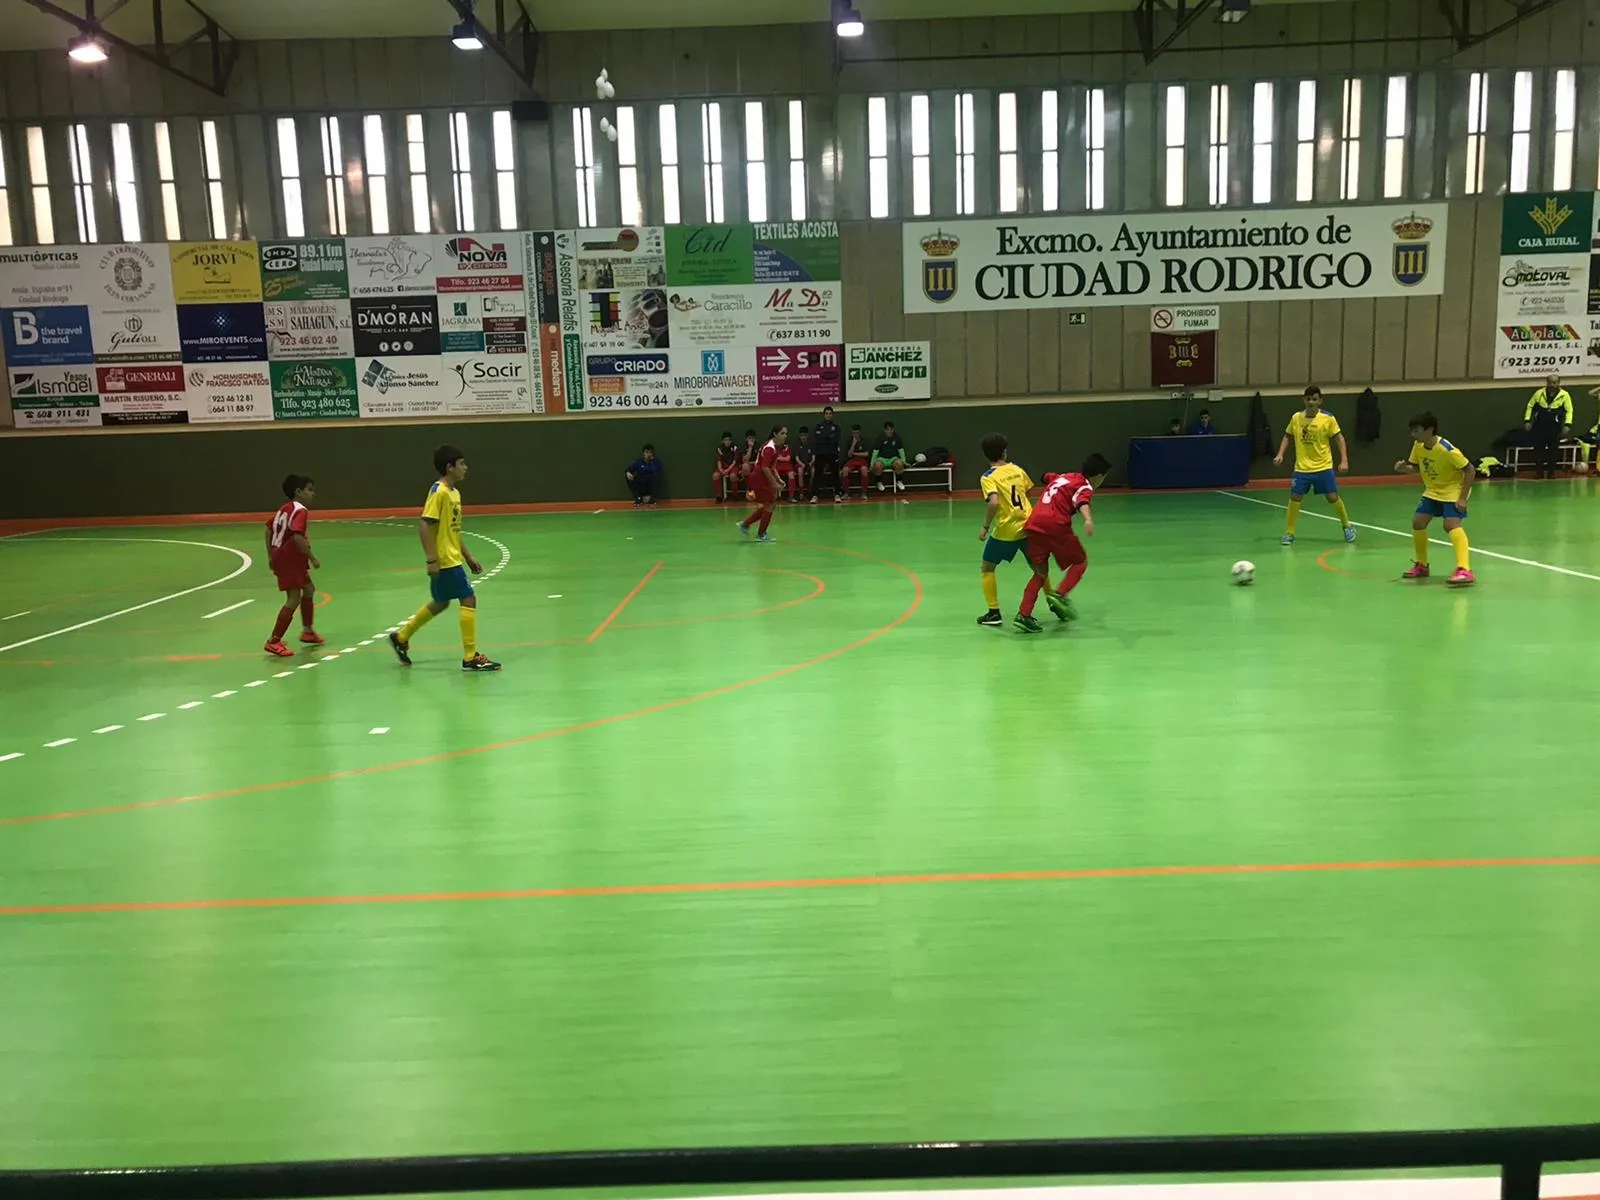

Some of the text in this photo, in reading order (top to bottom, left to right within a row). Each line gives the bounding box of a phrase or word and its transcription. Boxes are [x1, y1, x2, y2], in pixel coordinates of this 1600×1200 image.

[754, 221, 839, 240] TEXTILES ACOSTA
[996, 215, 1351, 257] Excmo. Ayuntamiento de
[1518, 237, 1580, 247] CAJA RURAL
[300, 244, 325, 258] 89.1
[326, 243, 342, 257] fm
[460, 251, 507, 262] NOVA
[193, 253, 236, 265] JORVI
[269, 260, 294, 268] CERO
[559, 252, 576, 296] Asesoría
[975, 251, 1372, 301] CIUDAD RODRIGO
[358, 310, 432, 326] D'MORAN
[1176, 309, 1217, 317] PROHIBIDO
[1184, 319, 1209, 327] FUMAR
[41, 325, 82, 335] the travel
[776, 329, 831, 338] 637 83 11 90
[42, 335, 69, 344] brand
[280, 337, 296, 345] 923
[312, 336, 323, 344] 02
[326, 335, 337, 344] 40
[614, 360, 666, 372] CRIADO
[1508, 355, 1580, 366] 923 250 971
[64, 371, 88, 381] Yesos
[473, 362, 522, 378] Sacir
[126, 371, 176, 382] GENERALI
[674, 375, 755, 389] MIROBRIGAWAGEN
[37, 377, 92, 394] Ismael
[301, 398, 317, 409] 923
[318, 397, 334, 408] 480
[335, 396, 350, 408] 625
[589, 394, 668, 407] 923 46 00 44
[76, 409, 90, 417] 431
[1010, 485, 1023, 510] 4
